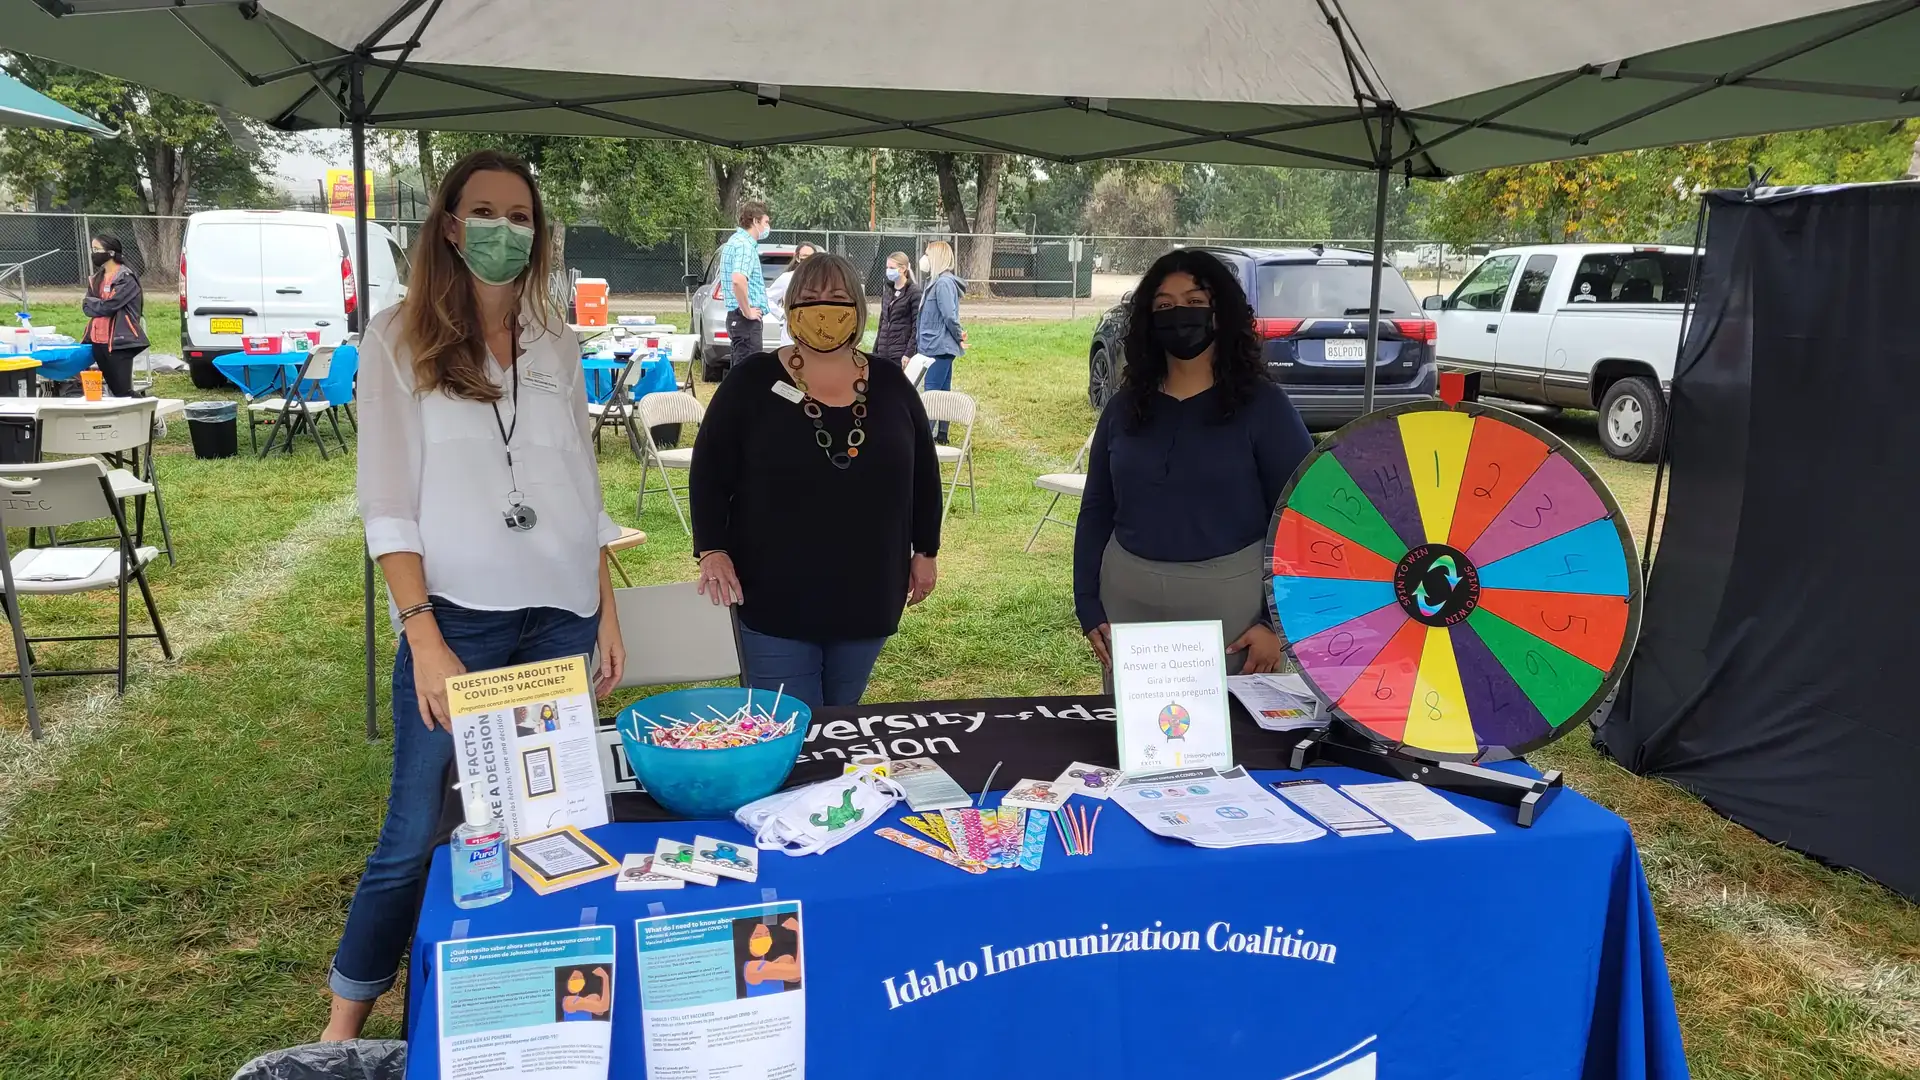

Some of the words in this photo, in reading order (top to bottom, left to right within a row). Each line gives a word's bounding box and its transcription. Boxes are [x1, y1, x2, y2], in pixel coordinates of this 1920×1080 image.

[1328, 346, 1363, 357] 8SLP070
[1374, 464, 1404, 500] 14
[1474, 462, 1501, 499] 2
[1326, 488, 1362, 525] 13
[1510, 494, 1552, 528] 3
[1310, 540, 1344, 568] 12
[1406, 548, 1428, 564] WIN
[1545, 554, 1588, 578] 4
[1398, 564, 1408, 578] TO
[1464, 566, 1478, 592] SPIN
[1397, 581, 1412, 606] SPIN
[1466, 595, 1476, 608] TO
[1445, 608, 1468, 624] WIN
[1540, 610, 1588, 634] 5
[1130, 644, 1150, 655] Spin
[1153, 644, 1168, 652] the
[1172, 642, 1204, 652] Wheel,
[1328, 632, 1364, 666] 10
[452, 674, 515, 691] QUESTIONS
[517, 666, 552, 680] ABOUT
[554, 662, 574, 673] THE
[1123, 662, 1158, 671] Answer
[1169, 657, 1215, 669] Question!
[464, 684, 514, 700] COVID-19
[516, 676, 566, 691] VACCINE?
[1147, 676, 1163, 684] Gira
[1174, 674, 1198, 683] rueda,
[1129, 690, 1164, 700] ¡contesta
[1182, 687, 1219, 698] pregunta!
[1424, 690, 1442, 721] 8
[497, 714, 506, 741] decisión
[803, 711, 986, 742] versity
[1036, 704, 1117, 721] Ida
[464, 726, 480, 776] FACTS,
[478, 714, 498, 784] DECISION
[796, 737, 960, 764] ension
[489, 786, 500, 796] A
[473, 847, 497, 860] Purell
[450, 954, 478, 963] COVID-19
[882, 959, 978, 1010] Idaho
[980, 920, 1200, 976] Immunization
[1206, 921, 1337, 964] Coalition
